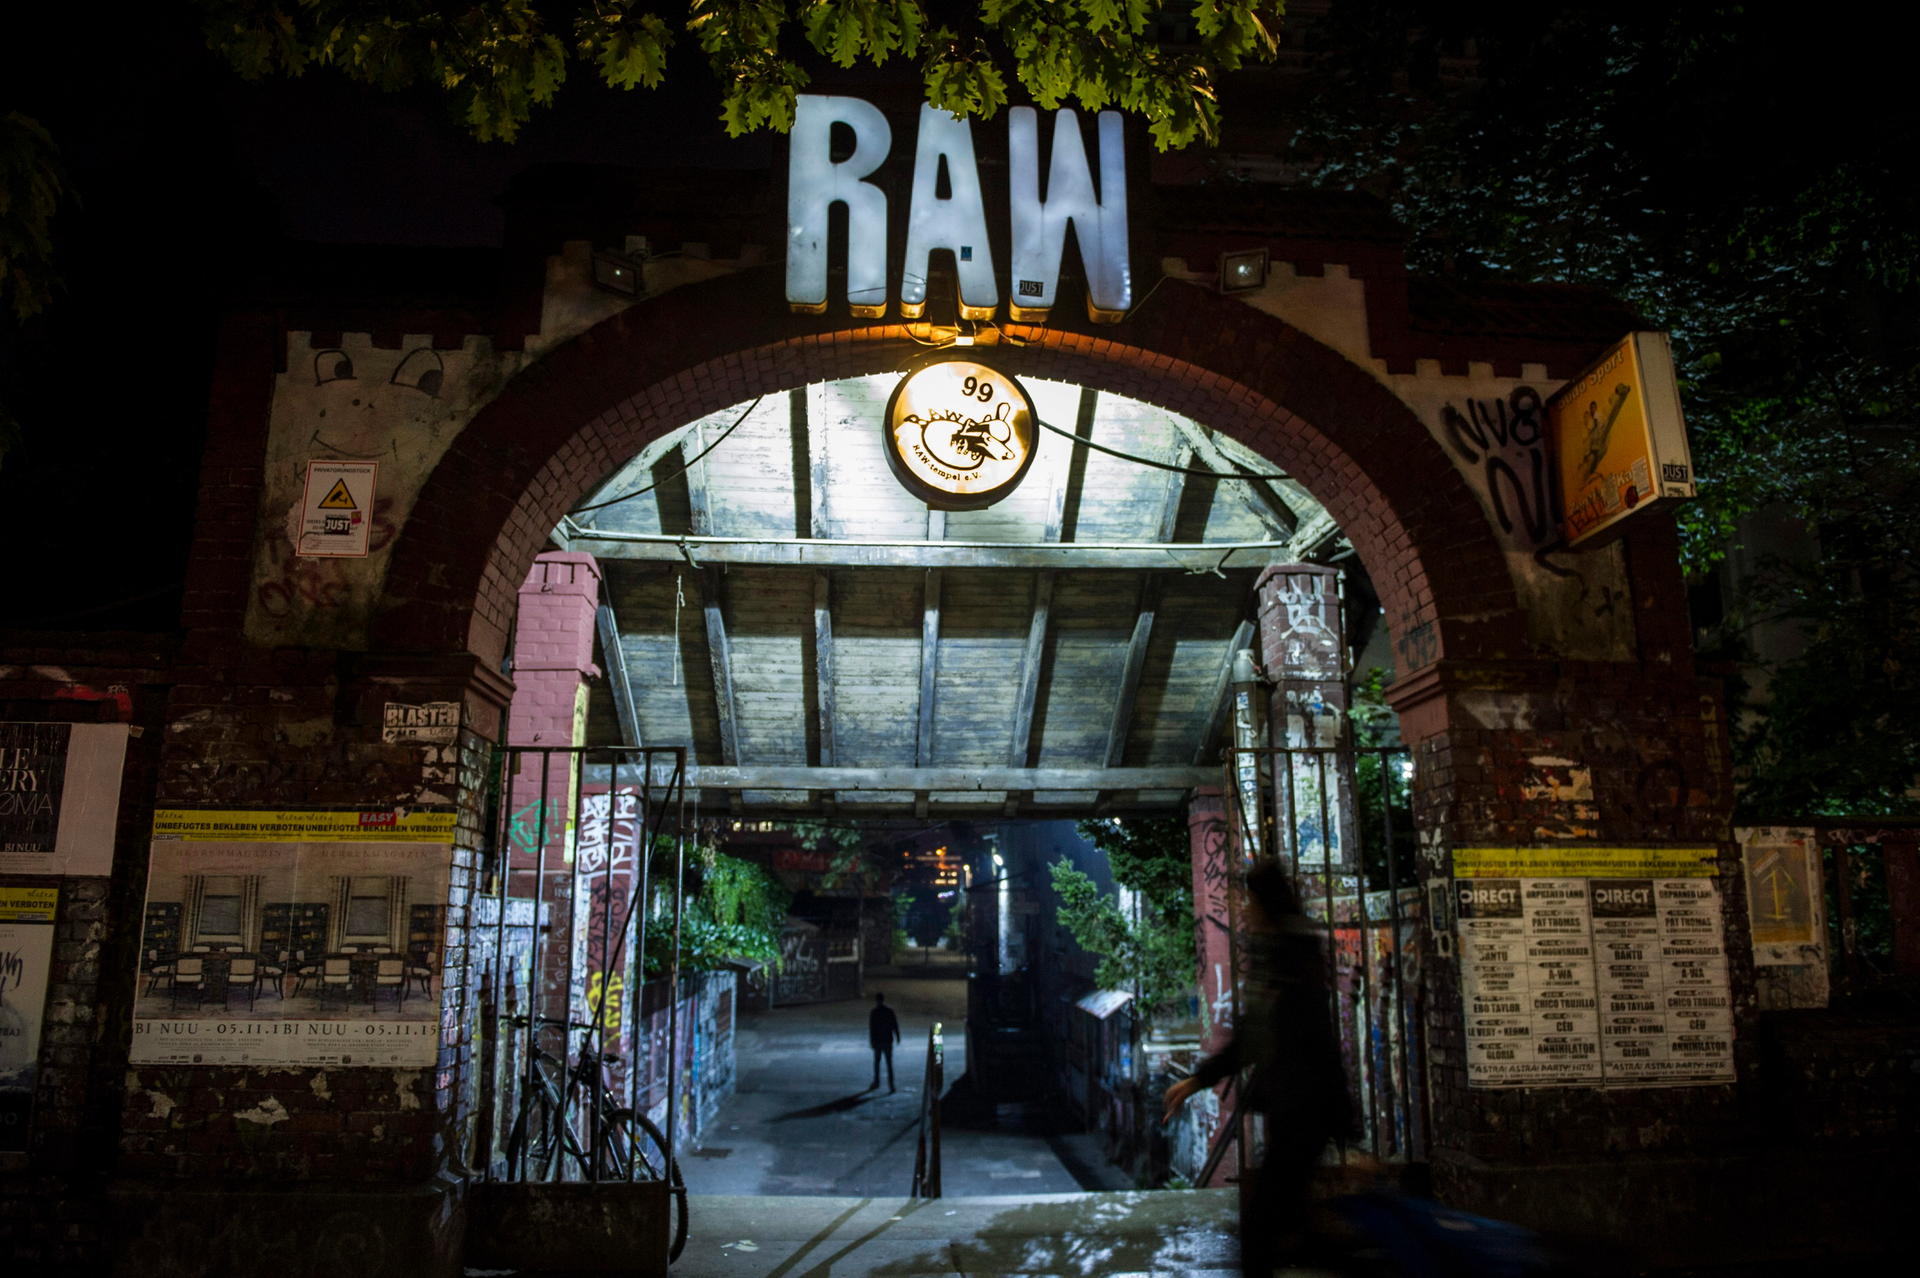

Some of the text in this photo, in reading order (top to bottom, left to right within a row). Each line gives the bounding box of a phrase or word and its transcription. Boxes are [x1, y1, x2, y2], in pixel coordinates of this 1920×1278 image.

[785, 93, 1132, 312] RAW
[1020, 282, 1043, 295] JUST
[1588, 350, 1625, 384] Sport
[962, 377, 994, 402] 99
[1664, 466, 1688, 480] JUST
[325, 519, 350, 531] JUST
[385, 708, 458, 726] BLASTED
[361, 814, 393, 824] EASY
[213, 823, 257, 831] BEKLEBEN
[16, 843, 41, 852] NUU
[10, 901, 54, 909] VERBOTEN
[1549, 918, 1580, 927] THOMAS
[1681, 918, 1711, 926] THOMAS
[1549, 969, 1573, 979] A-WA
[1534, 999, 1595, 1008] CHICO TRUJILLO
[1611, 1002, 1654, 1011] EBO TAYLOR
[1668, 998, 1726, 1007] CHICO TRUJILLO
[1474, 1003, 1520, 1013] EBO TAYLOR
[136, 1023, 151, 1034] BI
[160, 1023, 199, 1034] NUU
[284, 1024, 298, 1035] BI
[308, 1024, 347, 1035] NUU
[365, 1024, 437, 1036] 05.11.15
[1538, 1044, 1595, 1054] ANNIHILATOR
[1672, 1042, 1727, 1051] ANNIHILATOR
[1486, 1050, 1514, 1059] GLORIA
[1622, 1048, 1650, 1057] GLORIA
